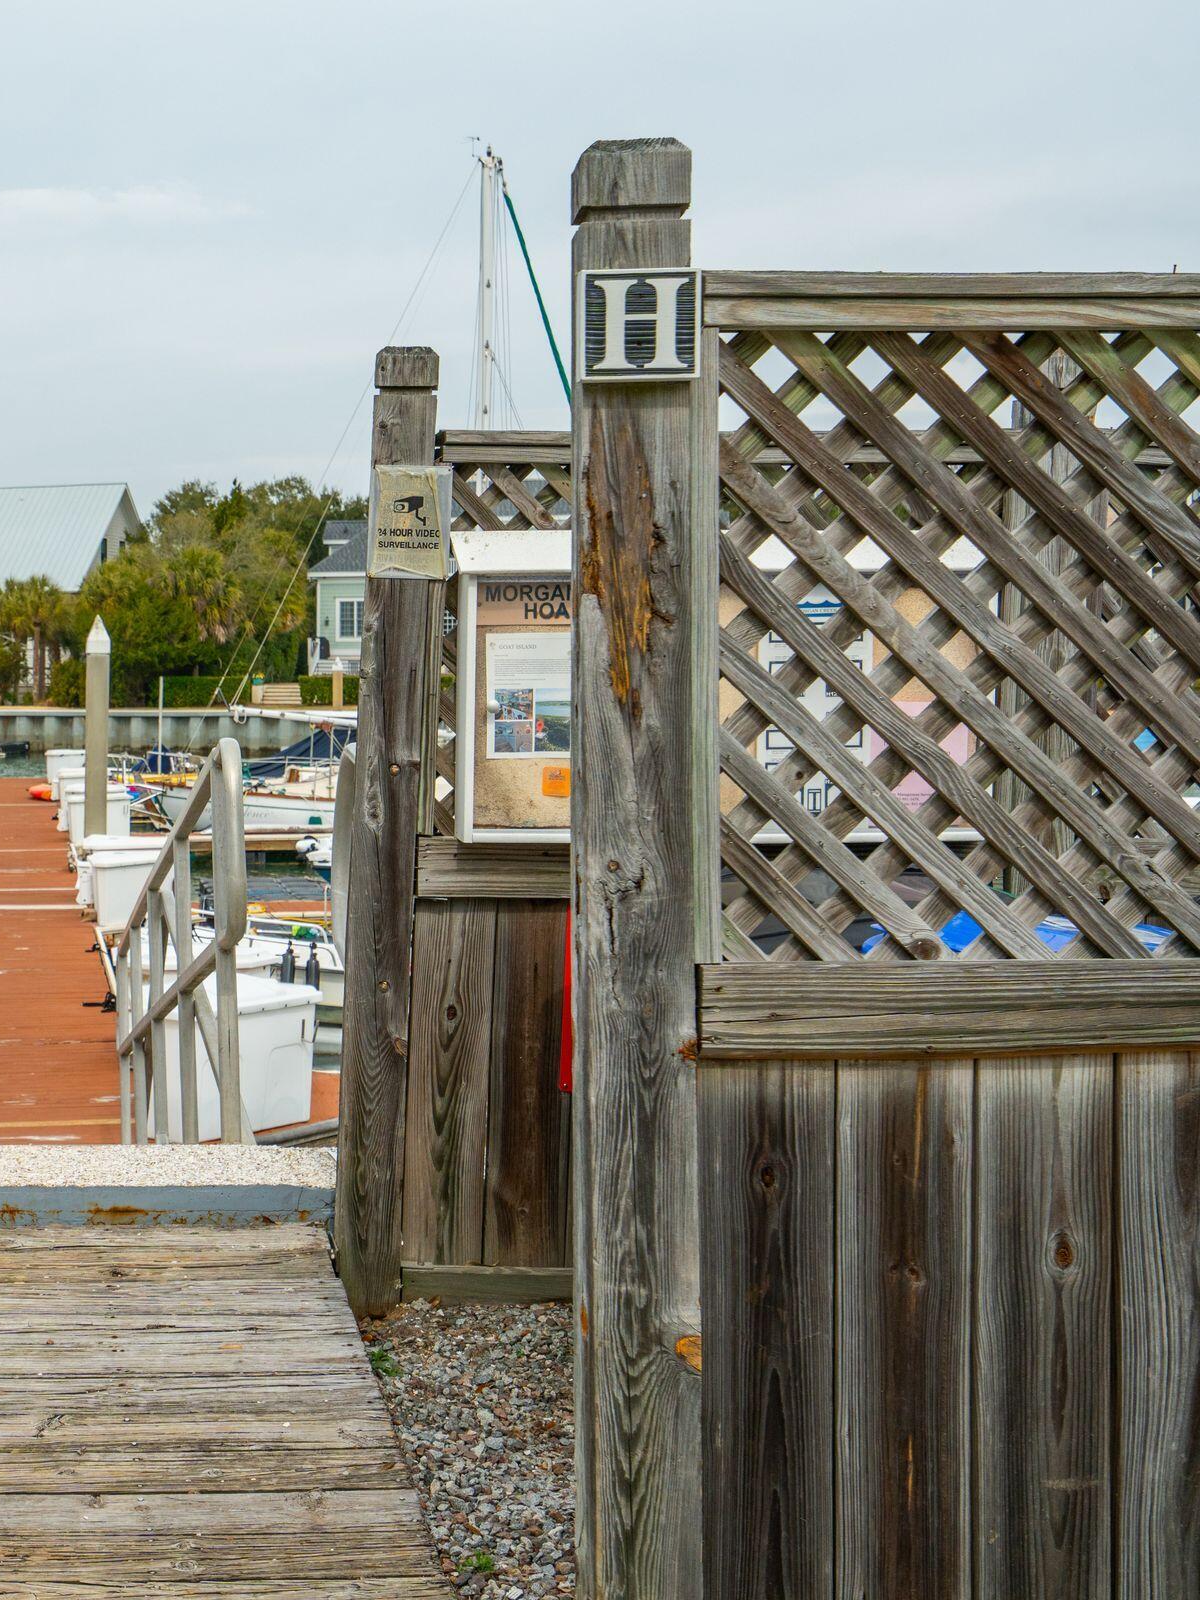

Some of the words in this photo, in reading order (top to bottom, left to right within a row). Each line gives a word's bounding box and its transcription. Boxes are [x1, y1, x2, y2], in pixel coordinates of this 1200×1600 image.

[593, 278, 690, 369] H
[377, 529, 387, 537] 24
[390, 529, 413, 537] HOUR
[378, 541, 439, 549] SURVEILLANCE
[524, 602, 570, 619] HOA
